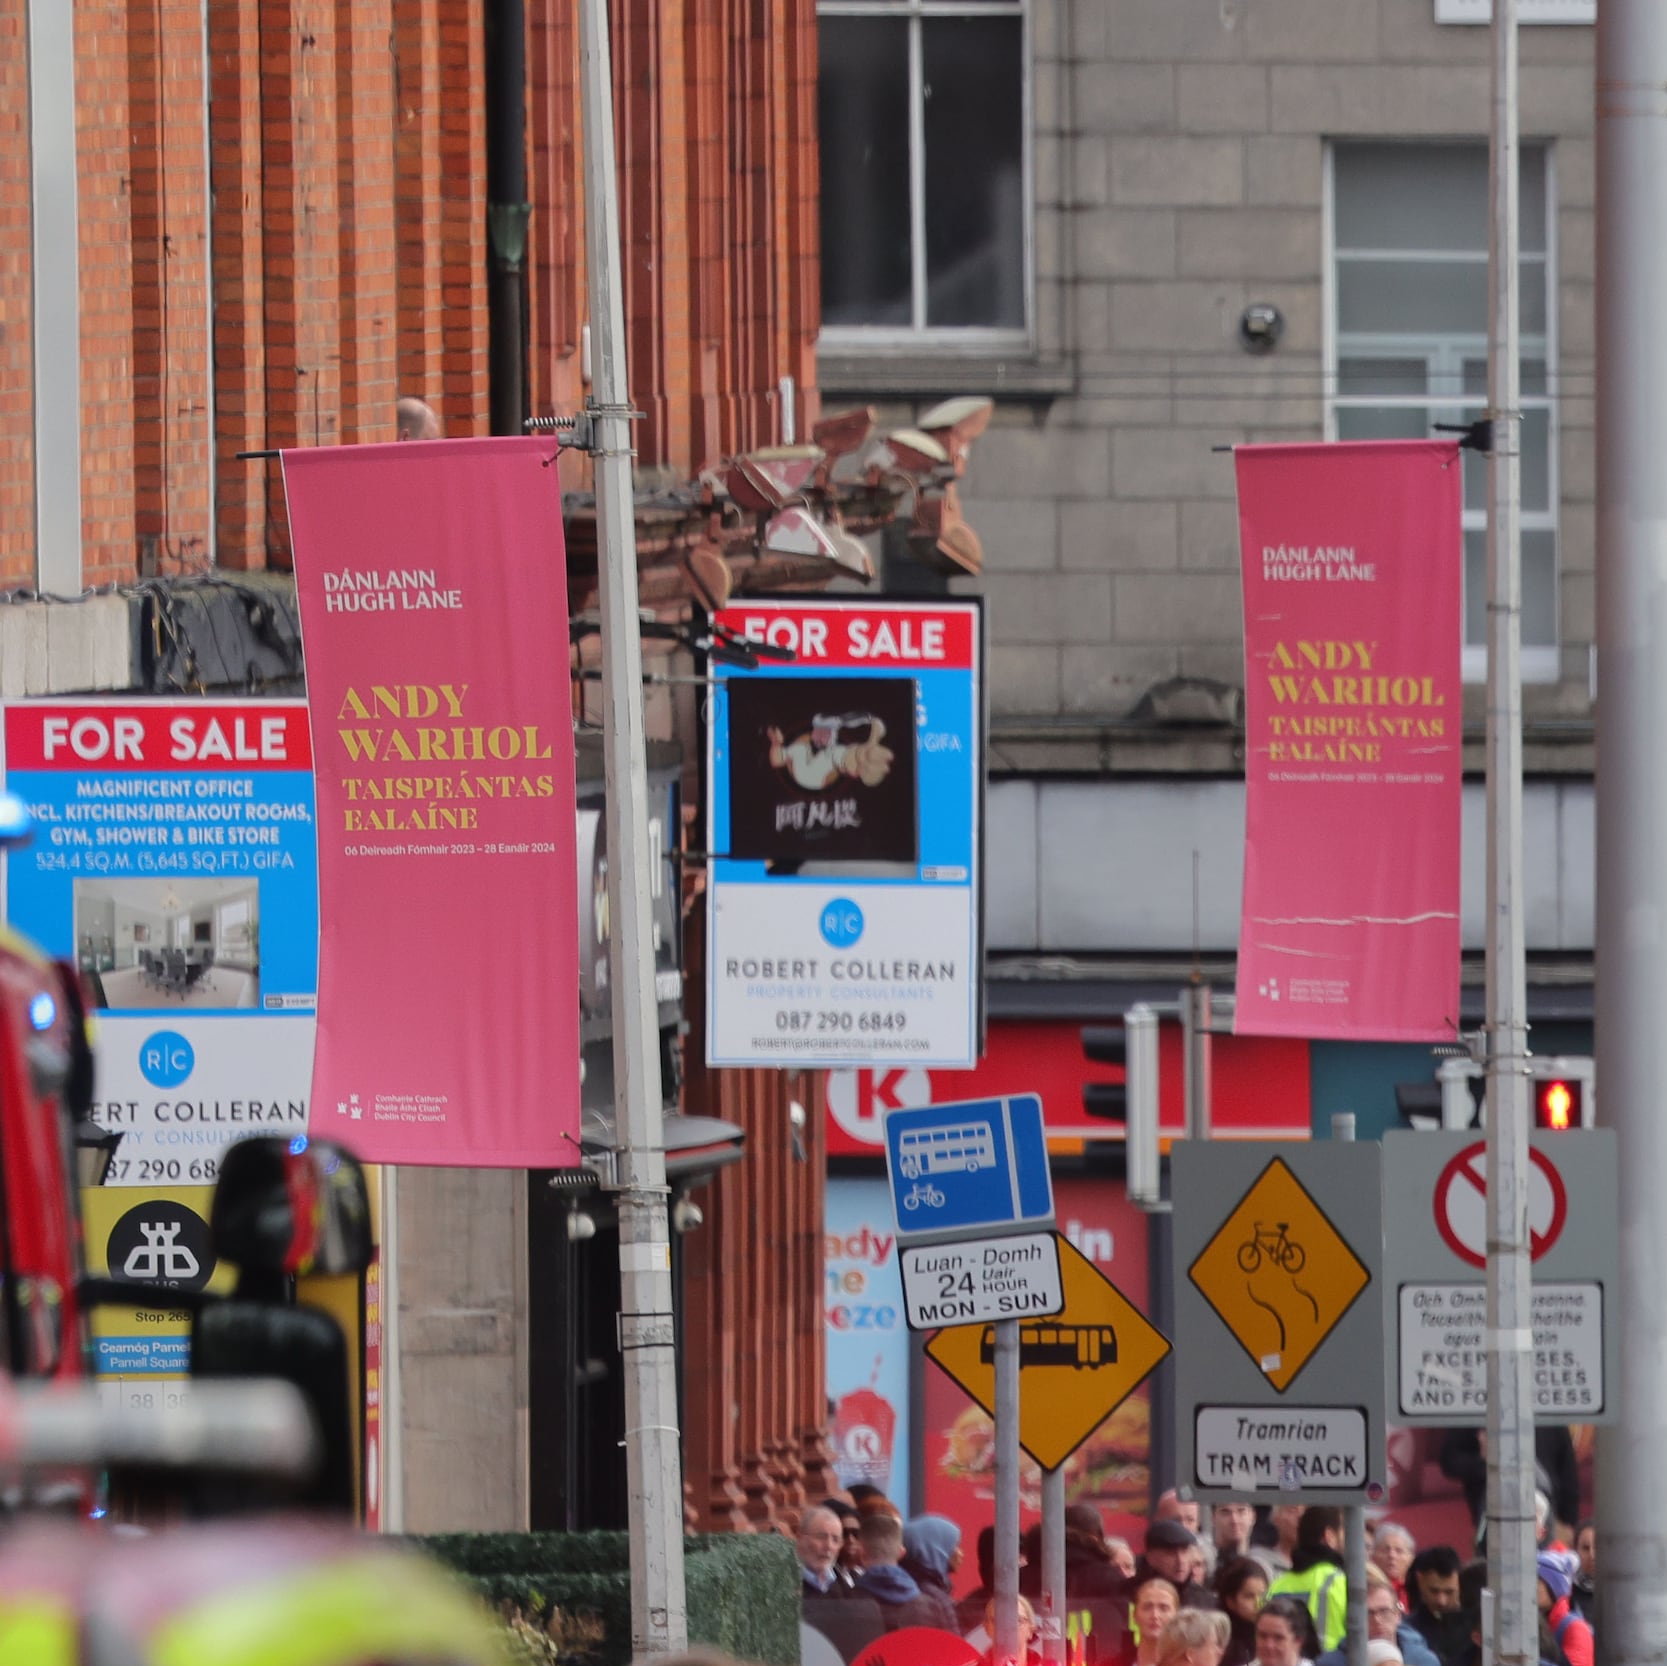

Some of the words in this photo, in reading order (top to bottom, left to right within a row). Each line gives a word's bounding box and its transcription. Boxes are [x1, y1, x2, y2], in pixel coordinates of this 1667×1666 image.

[1262, 544, 1355, 563] DÁNLANN
[323, 567, 436, 592] DÁNLANN
[1263, 564, 1321, 582] HUGH
[1325, 563, 1376, 582] LANE
[326, 592, 395, 614] HUGH
[402, 590, 464, 611] LANE
[745, 617, 829, 658] FOR
[847, 618, 946, 660] SALE
[1268, 641, 1378, 671] ANDY
[337, 684, 469, 720] ANDY
[1268, 676, 1445, 706] WARHOL
[1269, 712, 1445, 738] TAISPEÁNTAS
[42, 716, 145, 761] FOR
[169, 716, 288, 761] SALE
[338, 726, 553, 762] WARHOL
[1267, 739, 1382, 763] EALAÍNE
[77, 780, 192, 798] MAGNIFICENT
[195, 780, 254, 798] OFFICE
[342, 770, 554, 800] TAISPEÁNTAS
[26, 803, 61, 821] NCL.
[66, 803, 243, 821] KITCHENS/BREAKOUT
[245, 803, 312, 823] ROOMS,
[344, 802, 478, 831] EALAÍNE
[50, 827, 93, 847] GYM,
[96, 827, 169, 845] SHOWER
[172, 827, 184, 845] &
[188, 827, 225, 845] BIKE
[228, 827, 280, 845] STORE
[344, 846, 358, 856] 06
[359, 844, 406, 856] Deireadh
[408, 844, 449, 855] Fómhair
[450, 843, 475, 854] 2023
[484, 843, 497, 854] 28
[498, 843, 529, 854] Eanáir
[531, 843, 556, 853] 2024
[36, 851, 81, 871] 524.4
[254, 851, 294, 870] GIFA
[726, 959, 819, 980] ROBERT
[830, 960, 955, 982] COLLERAN
[775, 1011, 810, 1031] 087
[816, 1012, 852, 1031] 290
[857, 1012, 908, 1032] 6849
[857, 1067, 906, 1119] K
[91, 1101, 139, 1122] ERT
[154, 1100, 305, 1122] COLLERAN
[374, 1112, 400, 1121] Dublin
[401, 1112, 416, 1123] City
[417, 1113, 446, 1122] Council
[106, 1160, 131, 1180] 87
[139, 1160, 181, 1180] 290
[189, 1160, 220, 1179] 68
[914, 1254, 963, 1274] Luan
[982, 1244, 1042, 1265] Domh
[938, 1271, 977, 1299] 24
[982, 1267, 1016, 1281] Uair
[982, 1278, 1029, 1294] HOUR
[135, 1311, 165, 1324] Stop
[919, 1301, 976, 1322] MON
[998, 1291, 1048, 1313] SUN
[99, 1342, 150, 1355] Cearnóg
[152, 1342, 191, 1353] Parnel
[110, 1357, 148, 1368] Parnell
[150, 1357, 191, 1369] Square
[130, 1394, 154, 1410] 38
[1412, 1391, 1454, 1406] AND
[1462, 1391, 1487, 1405] FO
[1537, 1389, 1592, 1405] CESS
[1237, 1416, 1327, 1441] Tramrian
[854, 1433, 875, 1453] K
[1207, 1453, 1271, 1476] TRAM
